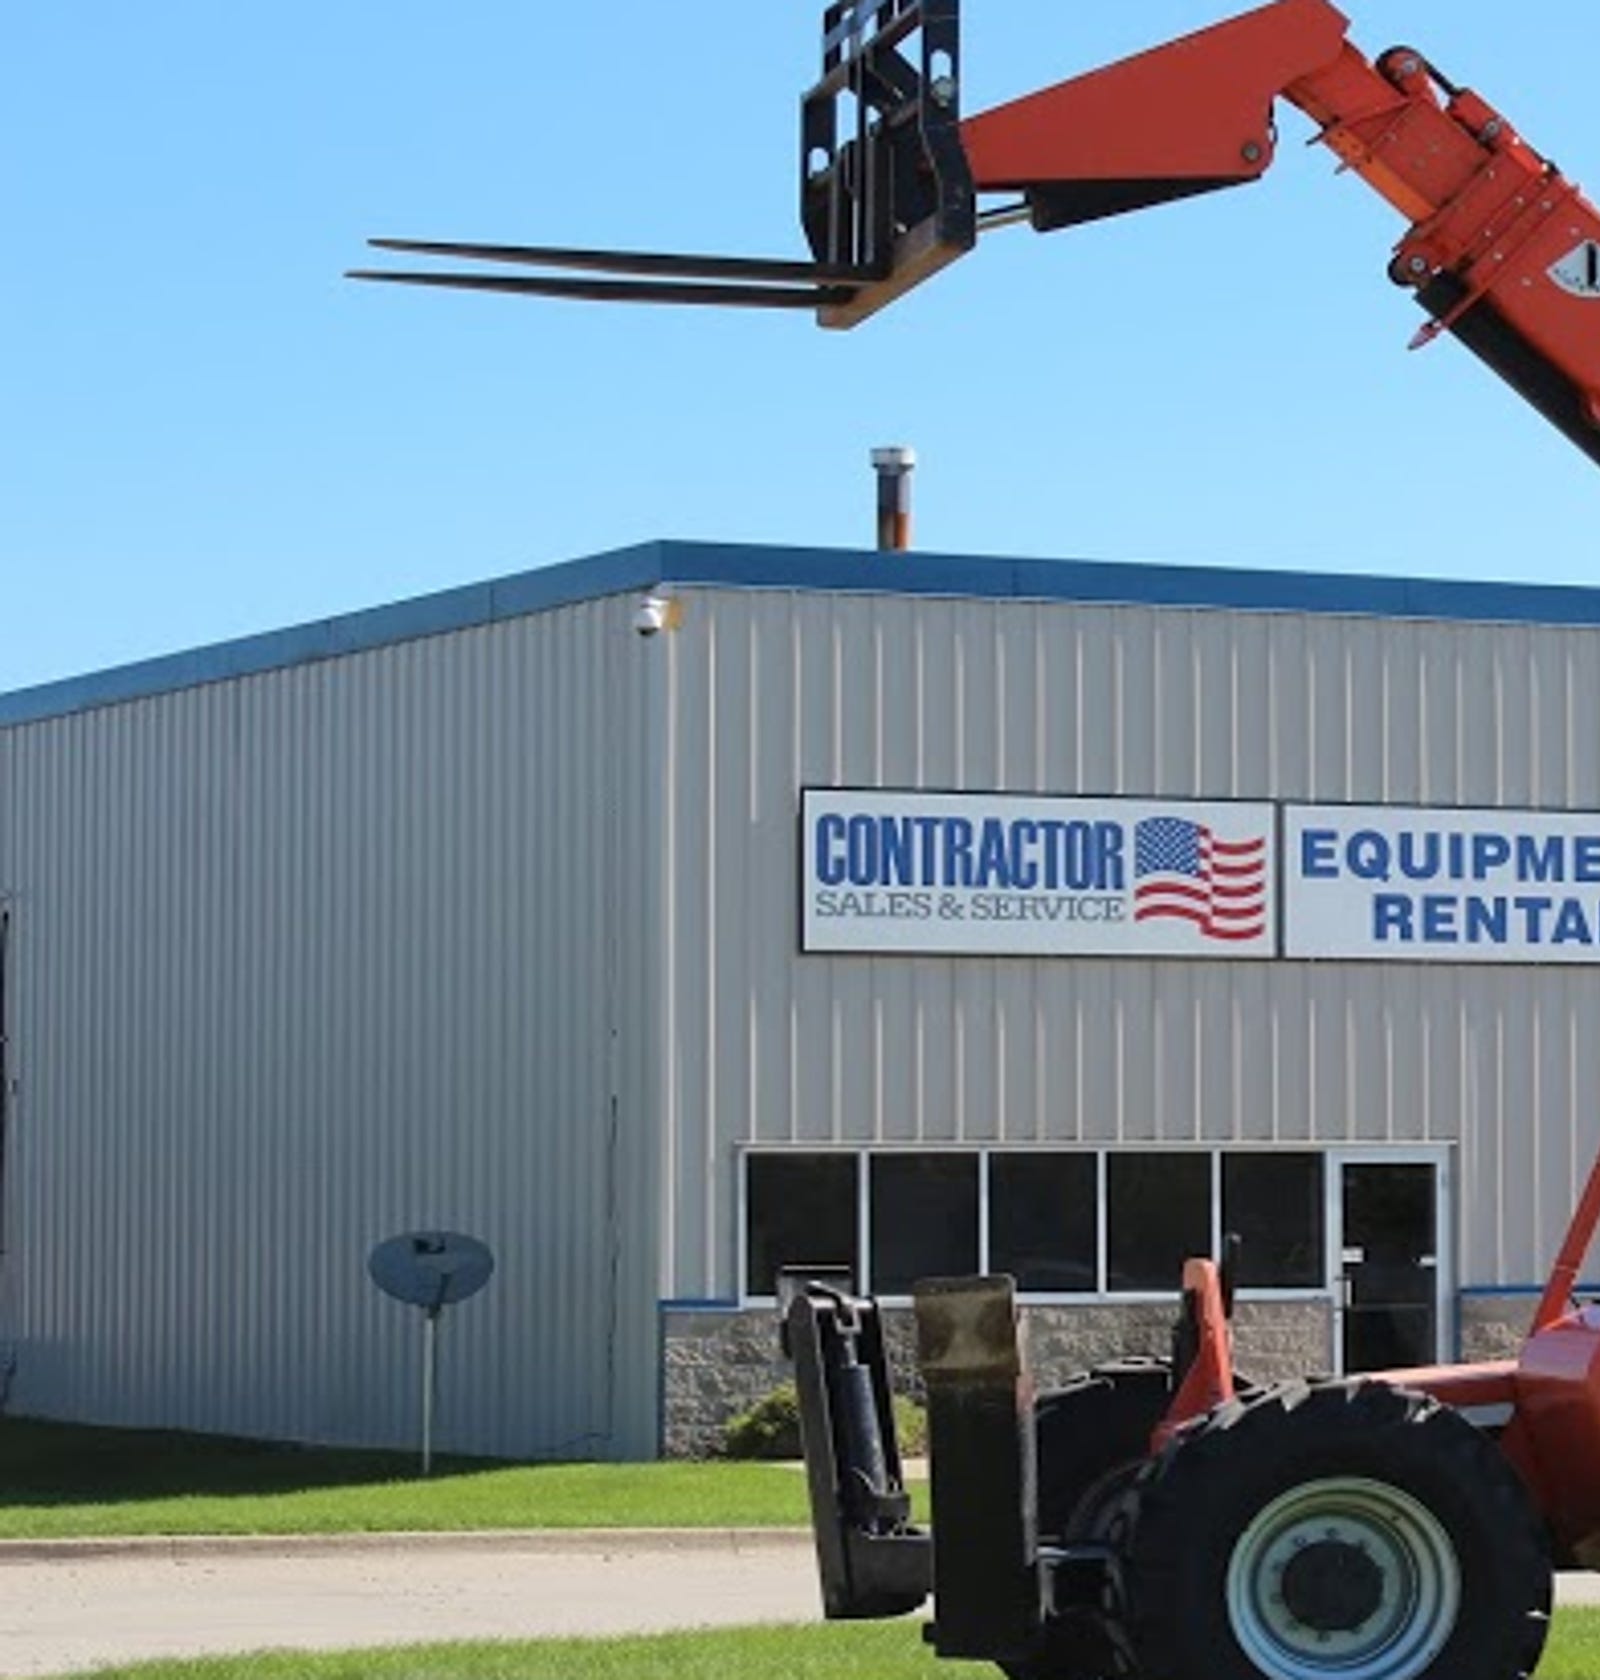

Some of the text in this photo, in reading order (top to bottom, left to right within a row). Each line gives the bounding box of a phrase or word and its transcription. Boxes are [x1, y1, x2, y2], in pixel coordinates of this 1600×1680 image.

[815, 813, 1125, 890] CONTRACTOR
[815, 891, 1126, 922] SALES & SERVICE
